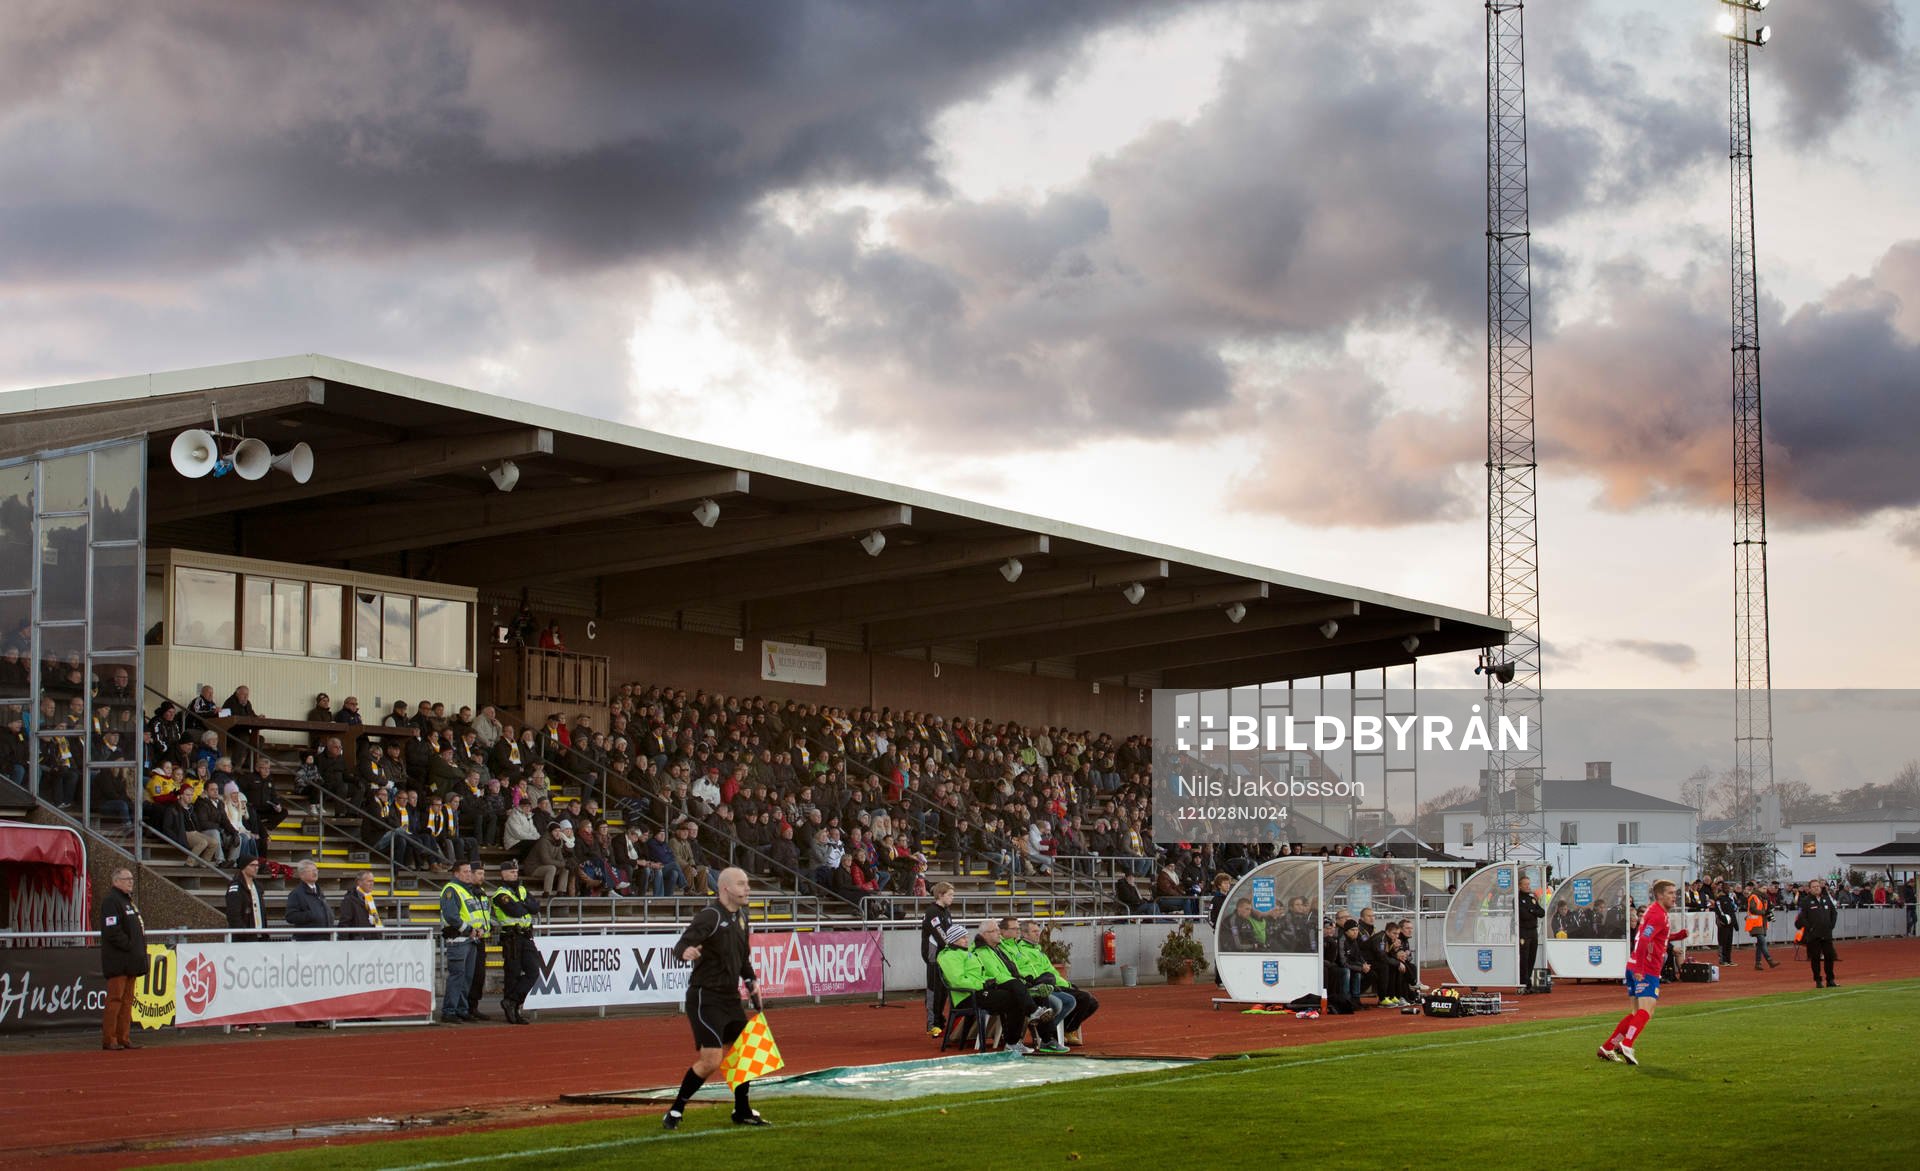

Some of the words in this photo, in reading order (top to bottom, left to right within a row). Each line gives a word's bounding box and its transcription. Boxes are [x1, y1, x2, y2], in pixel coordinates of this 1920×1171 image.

[587, 621, 596, 640] C
[933, 662, 940, 678] D
[565, 948, 621, 973] VINBERGS
[223, 951, 425, 991] Socialdemokraterna
[566, 974, 612, 993] MEKANISKA
[1431, 1001, 1452, 1009] SELECT
